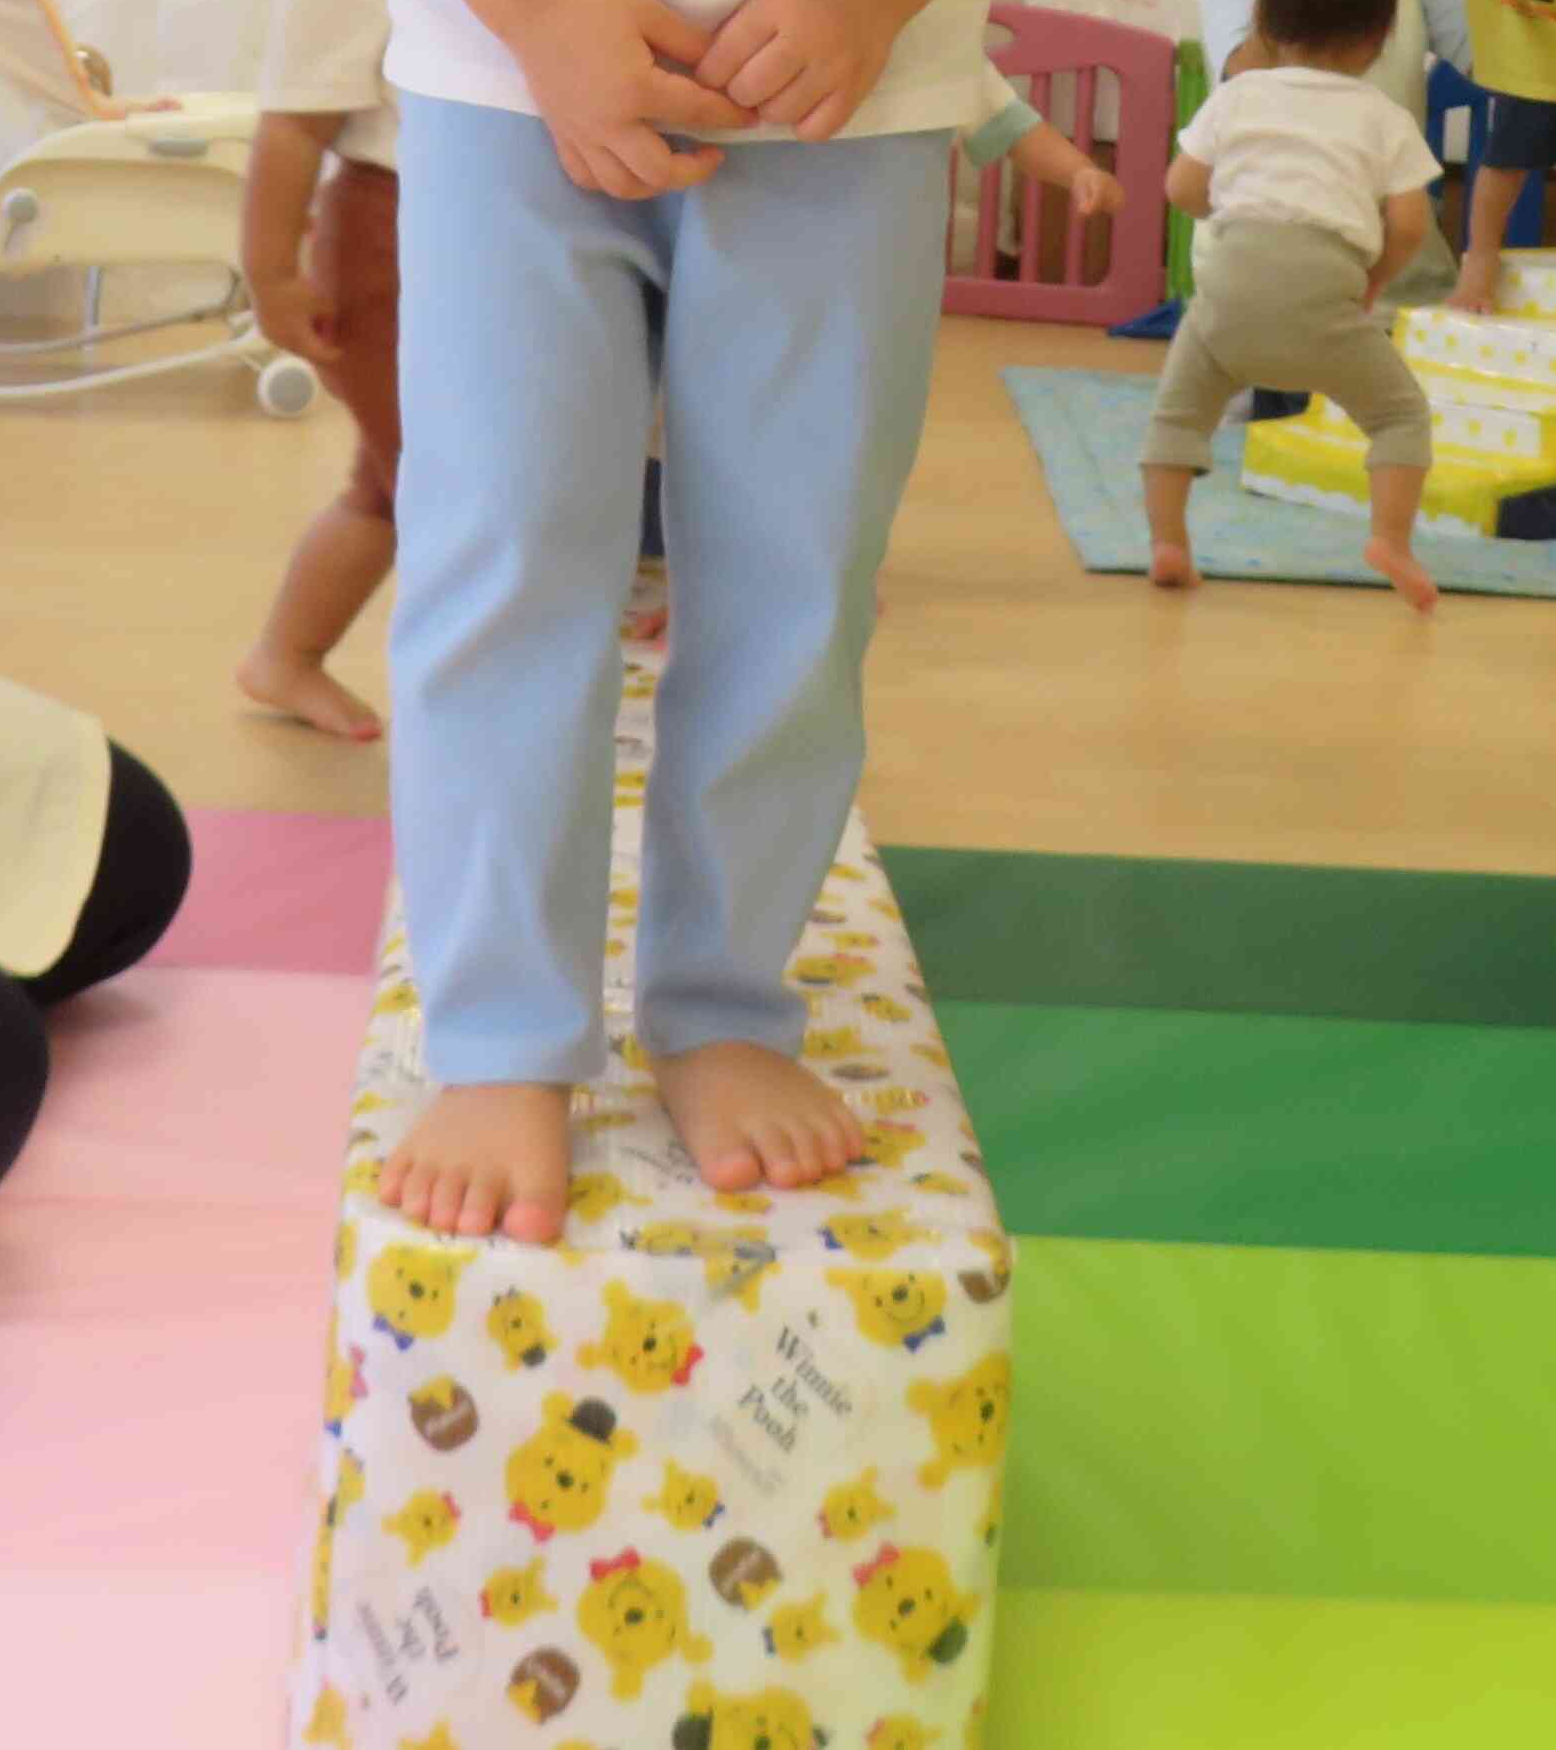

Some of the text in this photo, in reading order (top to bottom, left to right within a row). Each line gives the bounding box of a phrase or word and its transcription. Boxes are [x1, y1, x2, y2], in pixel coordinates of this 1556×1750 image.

[770, 1376, 810, 1419] the
[776, 1324, 852, 1417] Winnie
[738, 1384, 798, 1454] Pooh
